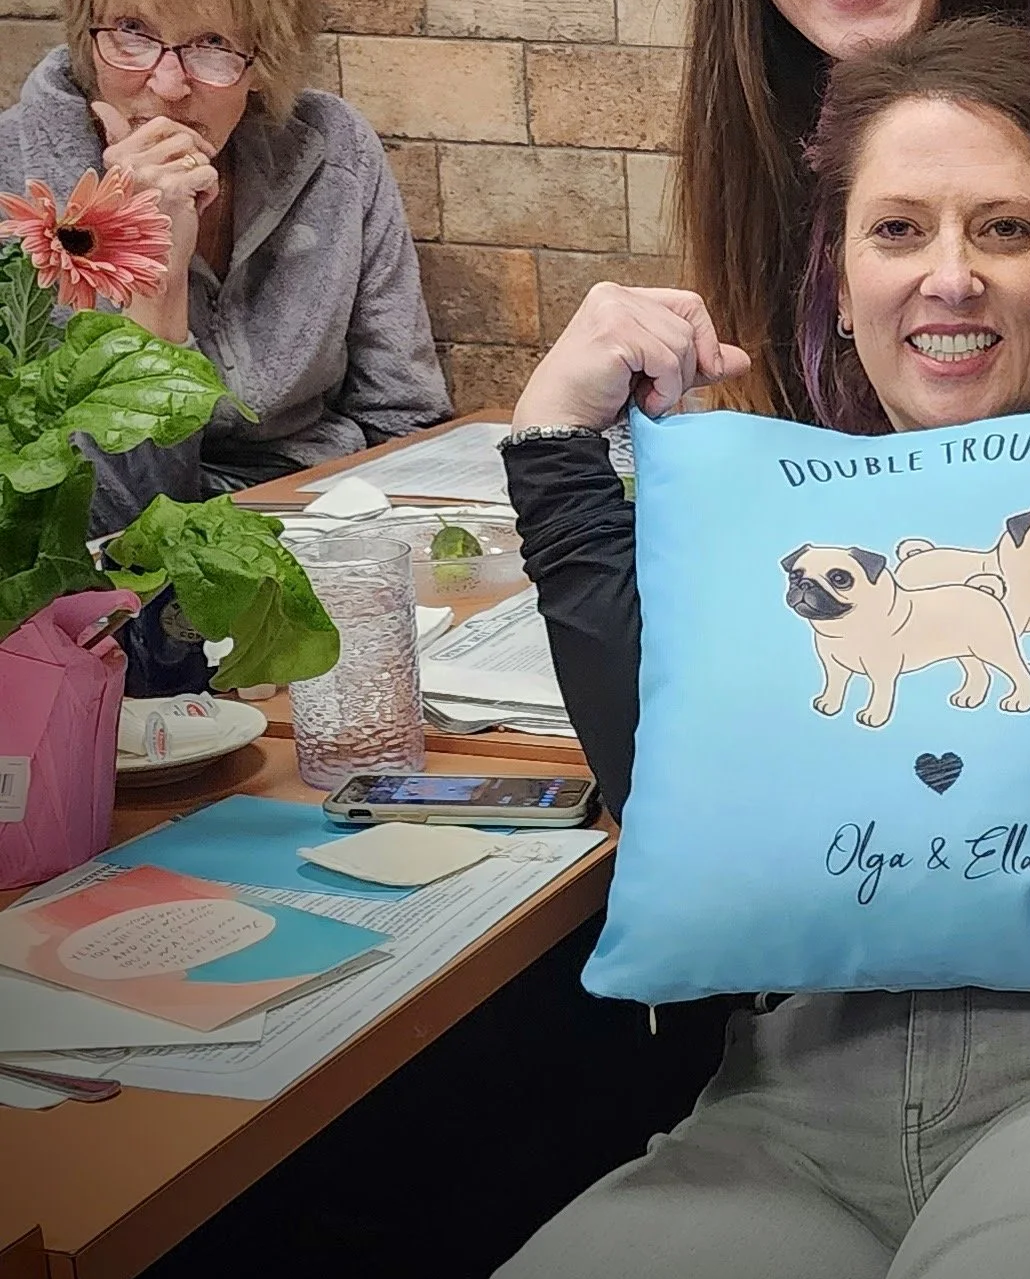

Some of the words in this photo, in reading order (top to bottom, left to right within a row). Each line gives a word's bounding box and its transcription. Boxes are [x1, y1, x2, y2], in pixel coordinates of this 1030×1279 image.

[779, 450, 923, 487] DOUBLE
[826, 820, 913, 905] Olga
[927, 836, 950, 870] &
